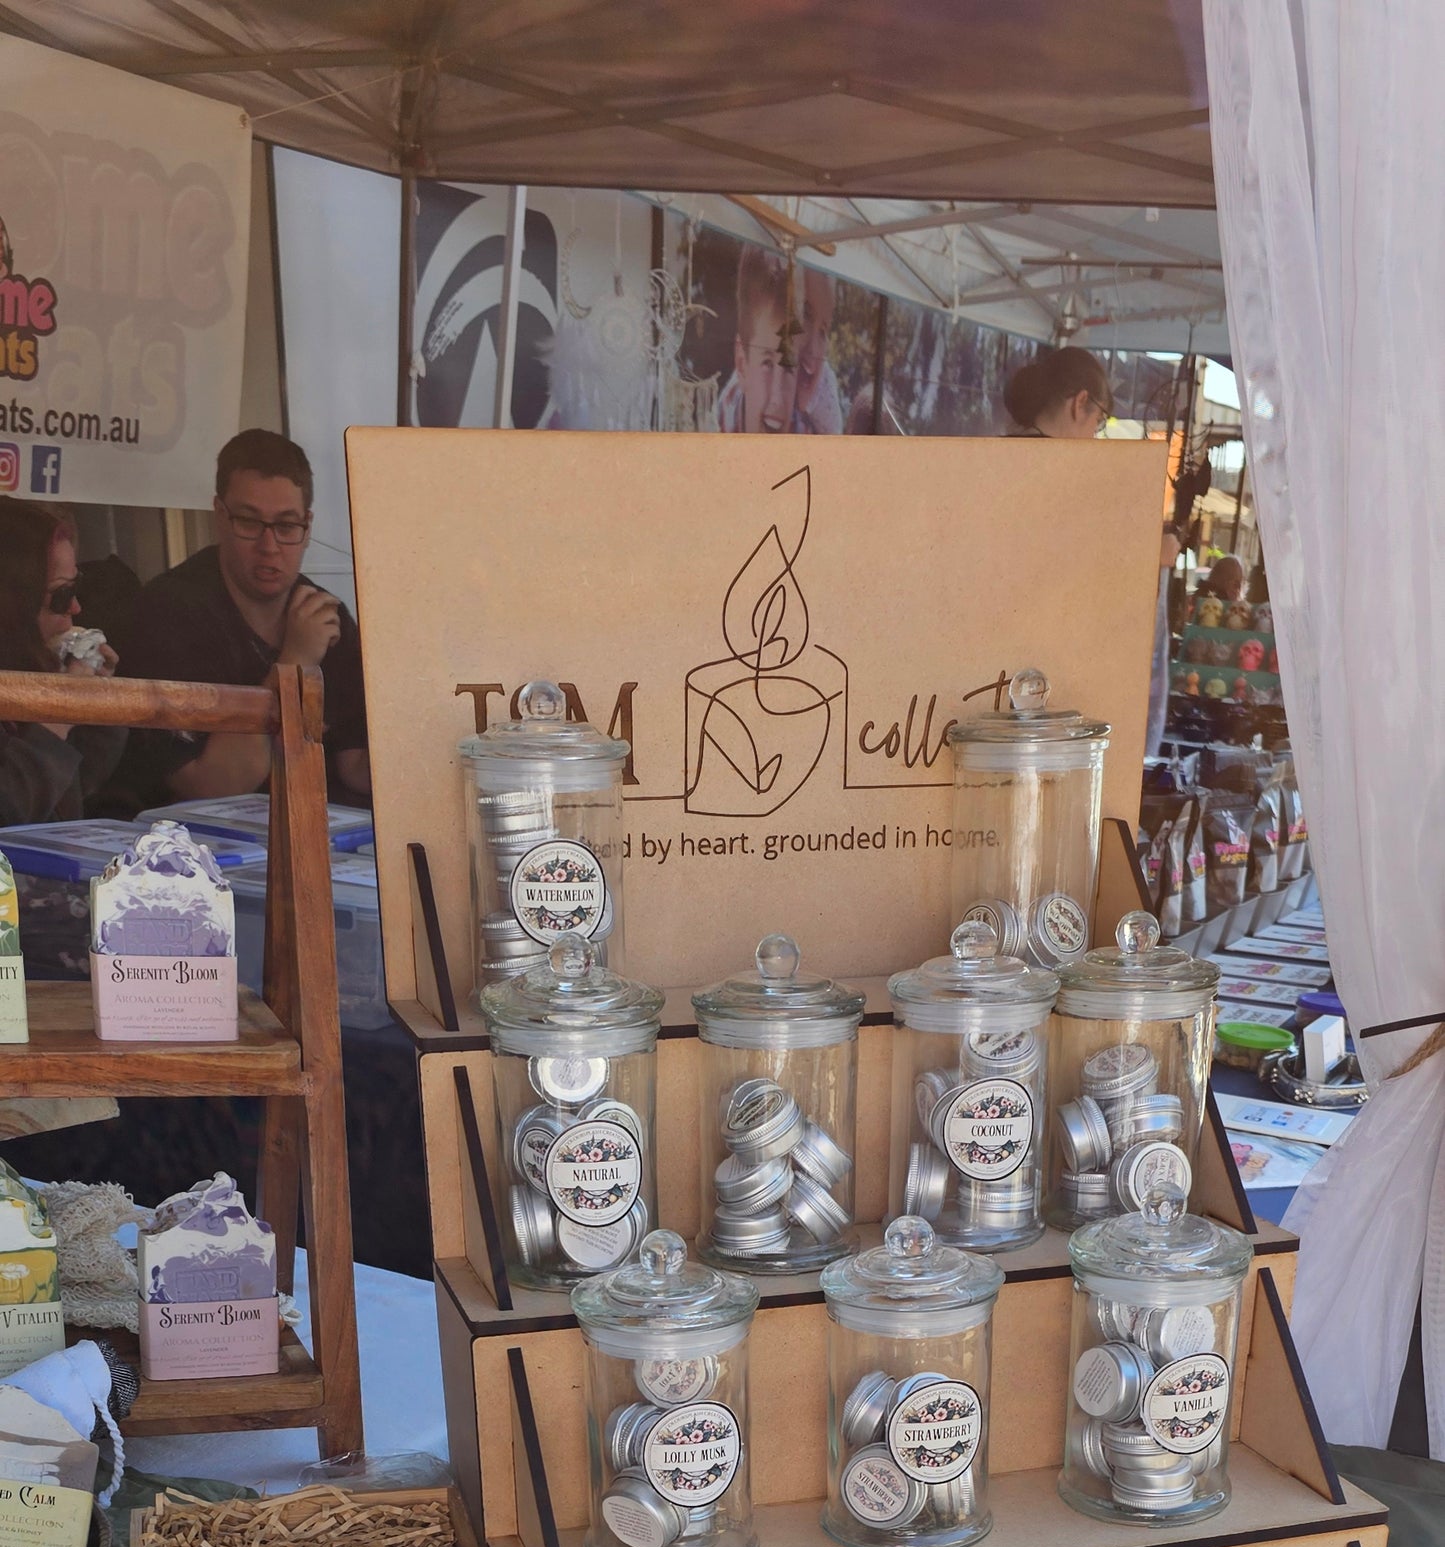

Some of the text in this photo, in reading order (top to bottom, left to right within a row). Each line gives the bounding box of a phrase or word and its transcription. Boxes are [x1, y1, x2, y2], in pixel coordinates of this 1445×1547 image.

[641, 833, 672, 865] by
[681, 831, 754, 857] heart.
[763, 824, 886, 861] grounded
[895, 826, 916, 848] in
[526, 888, 594, 902] WATERMELON
[971, 1124, 1014, 1137] COCONUT
[572, 1167, 621, 1182] NATURAL
[1173, 1395, 1213, 1413] VANILLA
[903, 1423, 973, 1443] STRAWBERRY
[664, 1445, 727, 1464] LOLLY MUSK
[857, 1470, 896, 1507] STRAWBERRY
